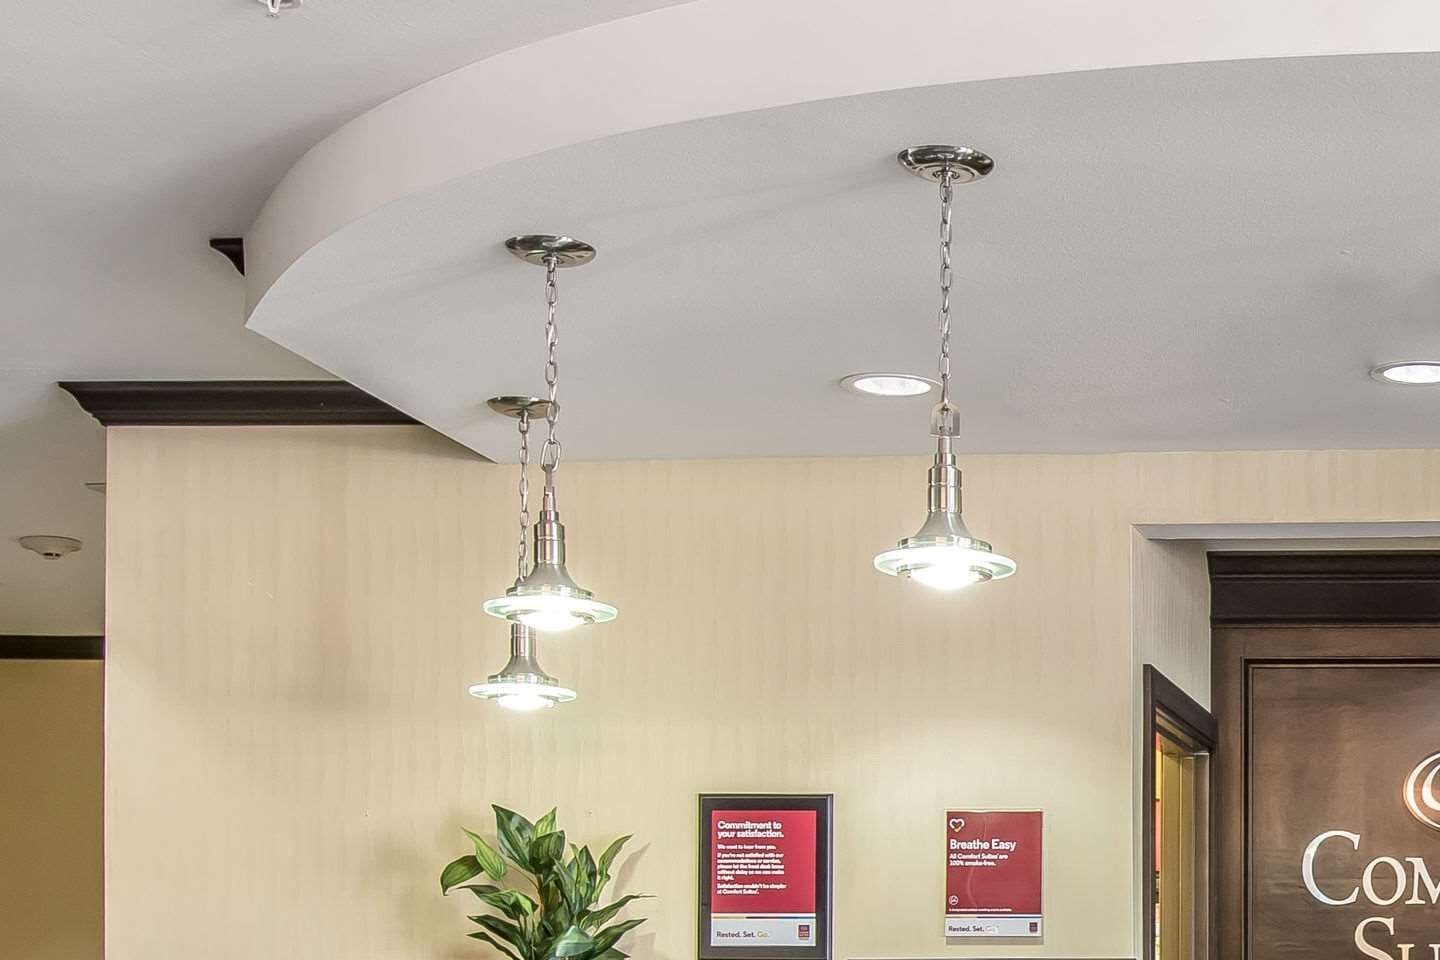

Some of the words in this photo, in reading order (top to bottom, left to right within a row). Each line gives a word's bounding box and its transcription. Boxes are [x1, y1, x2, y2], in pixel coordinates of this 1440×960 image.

[717, 820, 772, 829] Commitment
[773, 820, 782, 829] to
[717, 830, 736, 839] your
[736, 829, 785, 838] satisfaction.
[950, 838, 990, 850] Breathe
[991, 838, 1017, 852] Easy
[716, 930, 741, 938] Rested.
[743, 930, 756, 938] Set.
